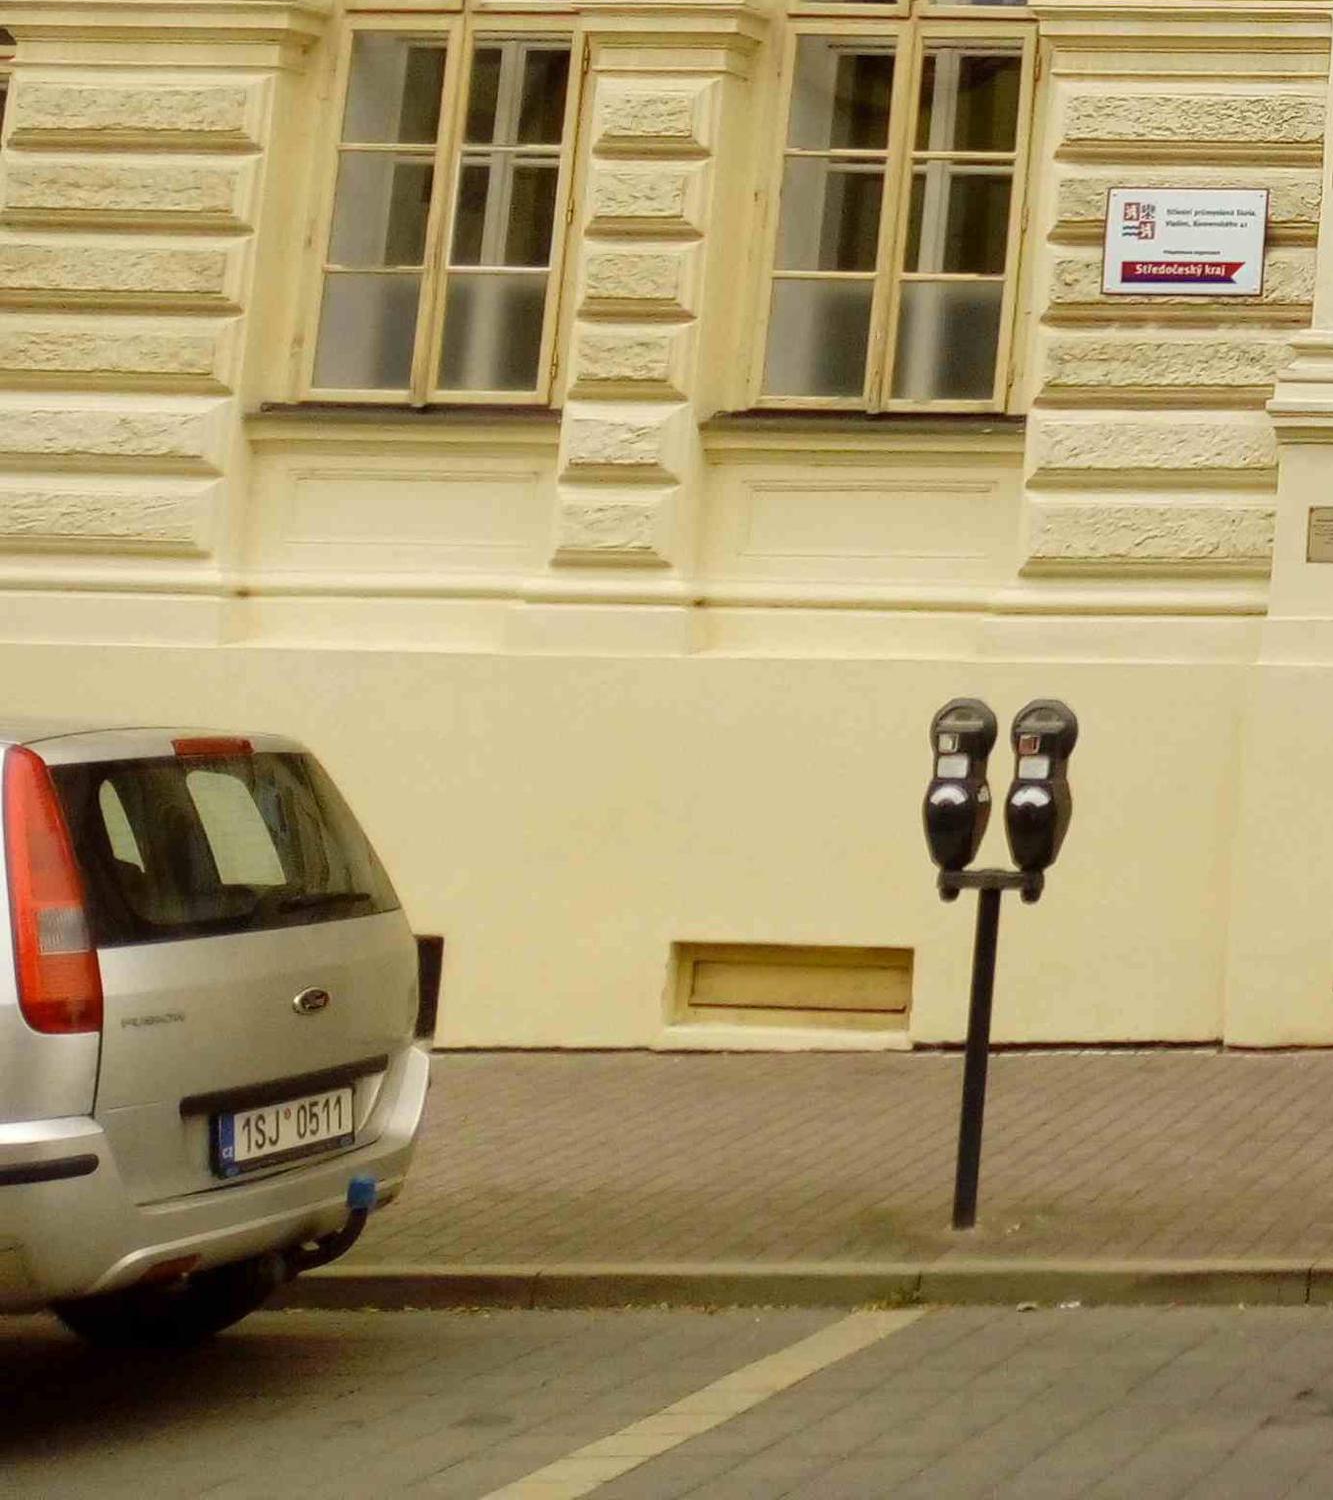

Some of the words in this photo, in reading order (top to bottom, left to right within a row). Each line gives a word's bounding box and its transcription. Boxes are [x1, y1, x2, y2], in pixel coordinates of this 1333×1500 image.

[1134, 263, 1203, 277] Středočeský
[1204, 264, 1226, 277] kraj
[242, 1110, 280, 1154] 1SJ
[296, 1095, 344, 1140] 0511
